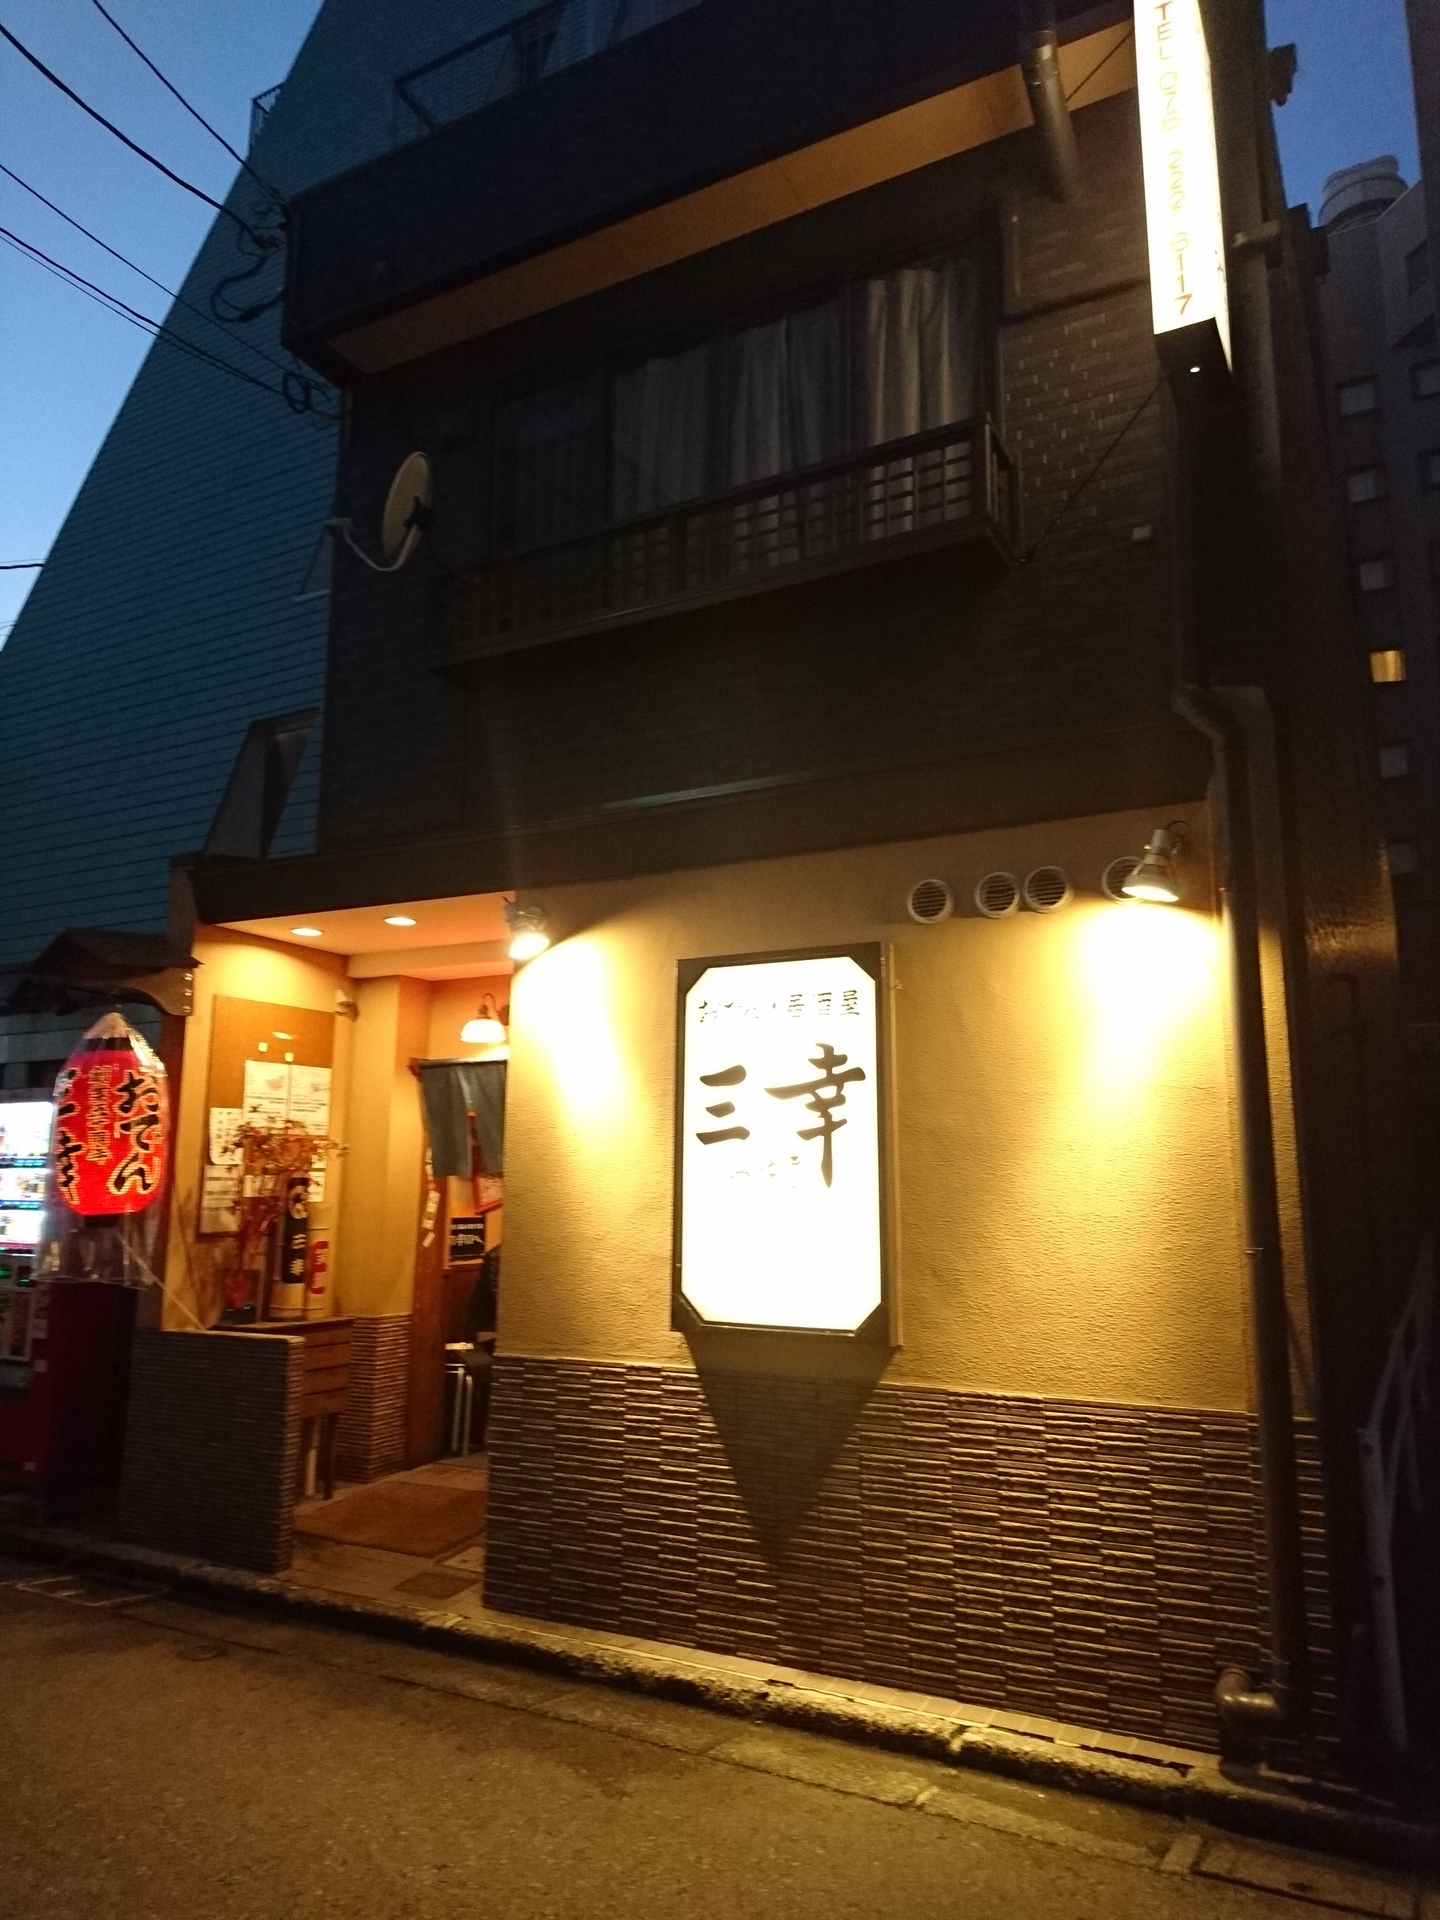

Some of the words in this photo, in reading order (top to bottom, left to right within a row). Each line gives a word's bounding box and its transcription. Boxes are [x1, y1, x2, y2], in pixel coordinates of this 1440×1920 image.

[1155, 1, 1175, 62] TEL
[1159, 71, 1181, 131] 076
[1168, 150, 1187, 211] 222
[1170, 231, 1193, 316] 6117
[107, 1069, 161, 1195] おでん
[695, 1042, 866, 1188] 三幸
